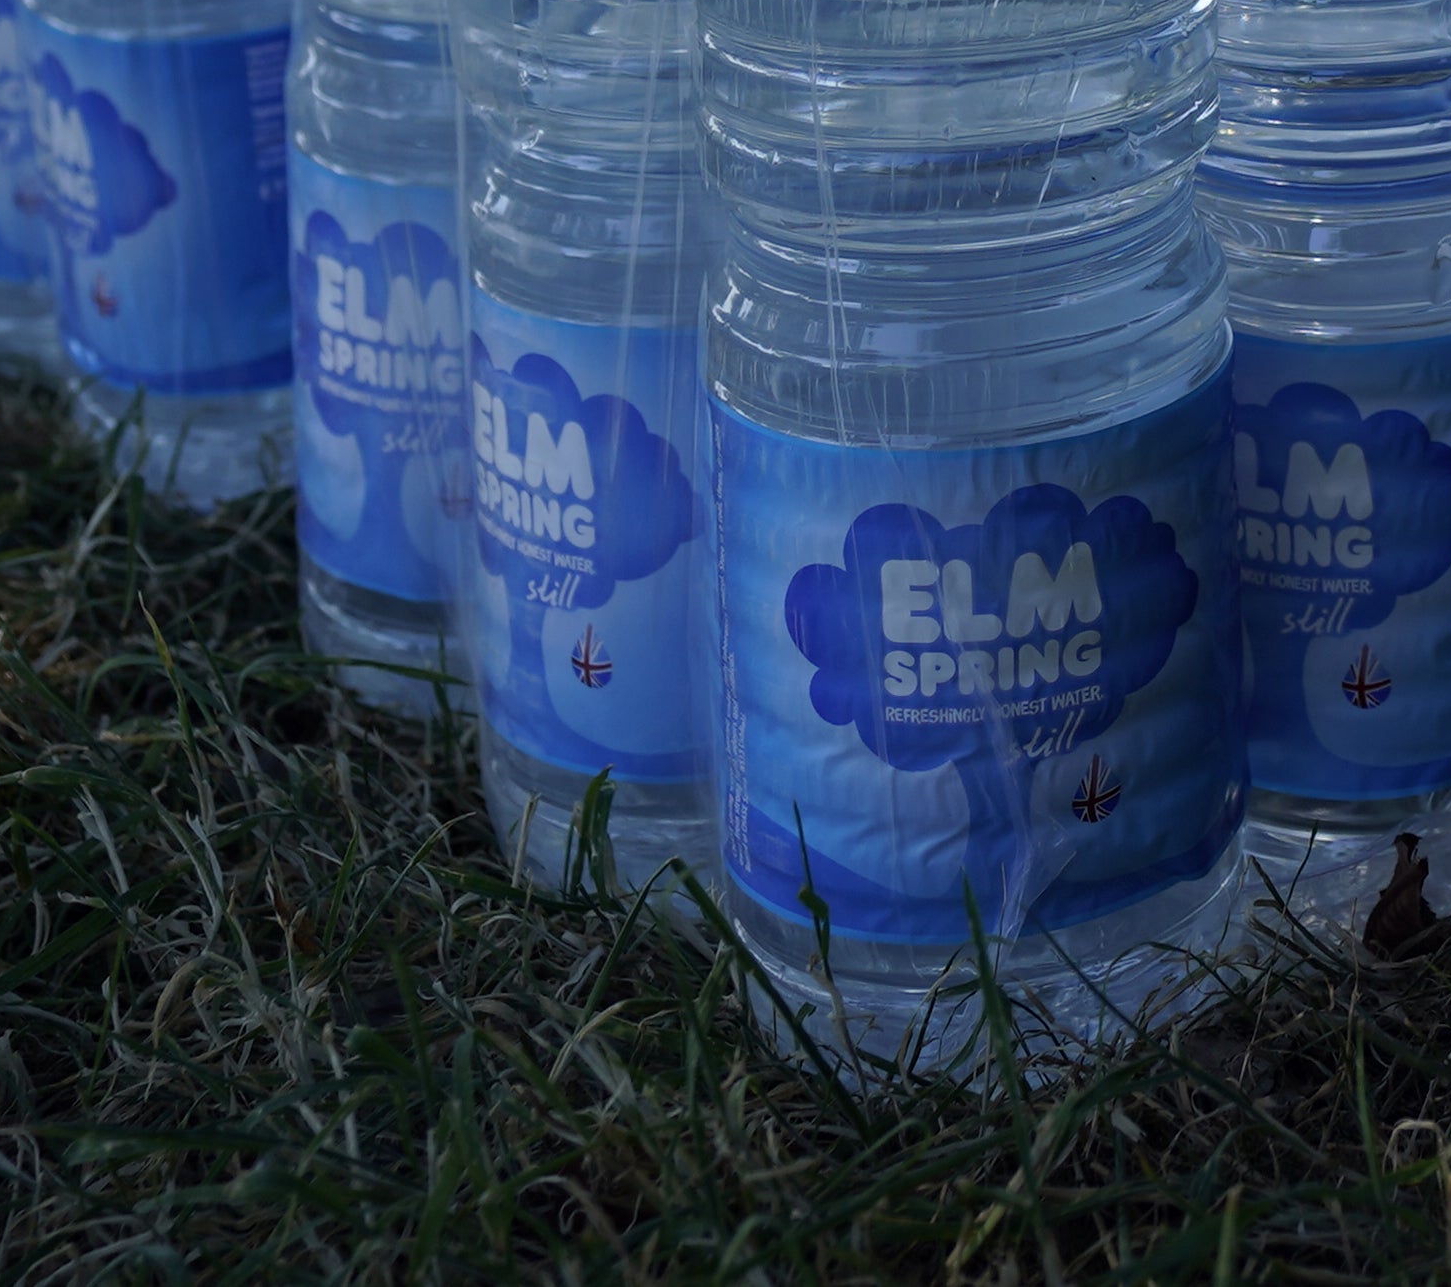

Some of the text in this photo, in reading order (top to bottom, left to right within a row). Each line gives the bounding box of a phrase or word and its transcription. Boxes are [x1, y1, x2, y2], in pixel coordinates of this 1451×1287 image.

[317, 254, 460, 350] ELM
[318, 329, 461, 395] SPRING
[473, 379, 596, 501] ELM
[1234, 431, 1375, 521] LM
[476, 460, 596, 549] SPRING
[1236, 516, 1375, 569] RING
[525, 571, 581, 610] still
[880, 541, 1103, 644] ELM
[1279, 596, 1355, 635] still
[882, 630, 1102, 698] SPRING
